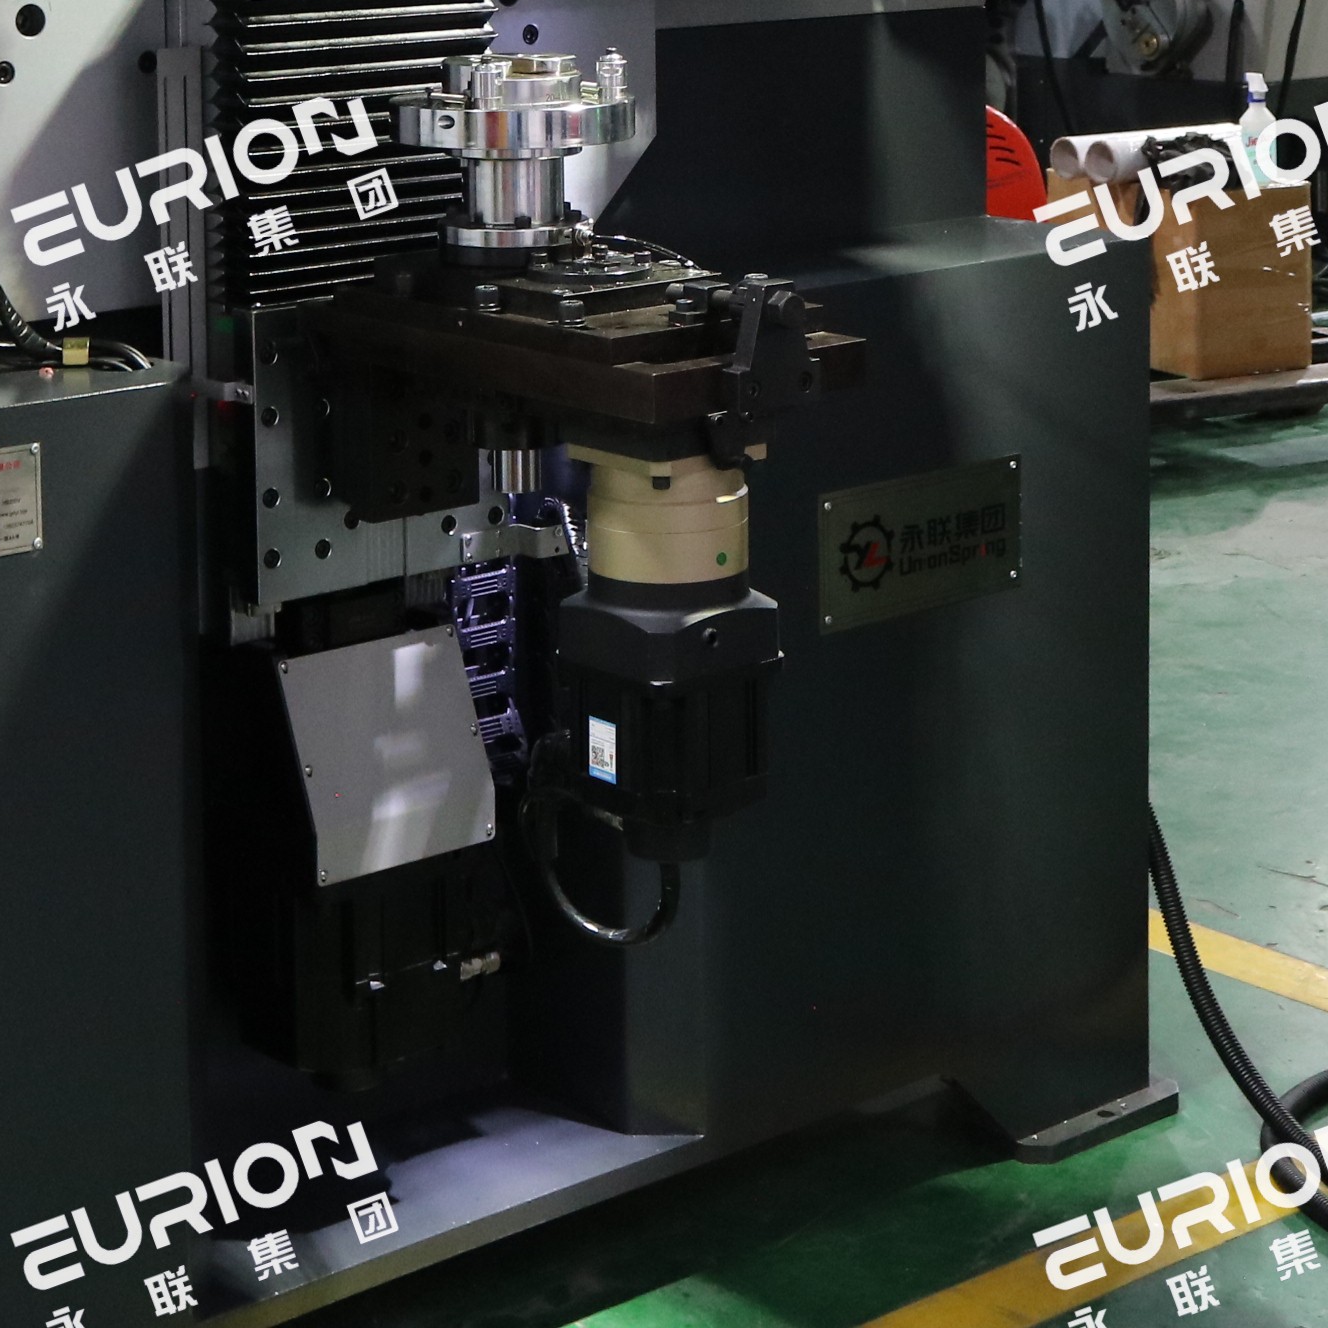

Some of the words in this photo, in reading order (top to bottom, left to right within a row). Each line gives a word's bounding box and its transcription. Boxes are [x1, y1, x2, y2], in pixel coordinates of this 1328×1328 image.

[900, 503, 1007, 554] 永联集团
[899, 537, 1007, 577] UnionSpring
